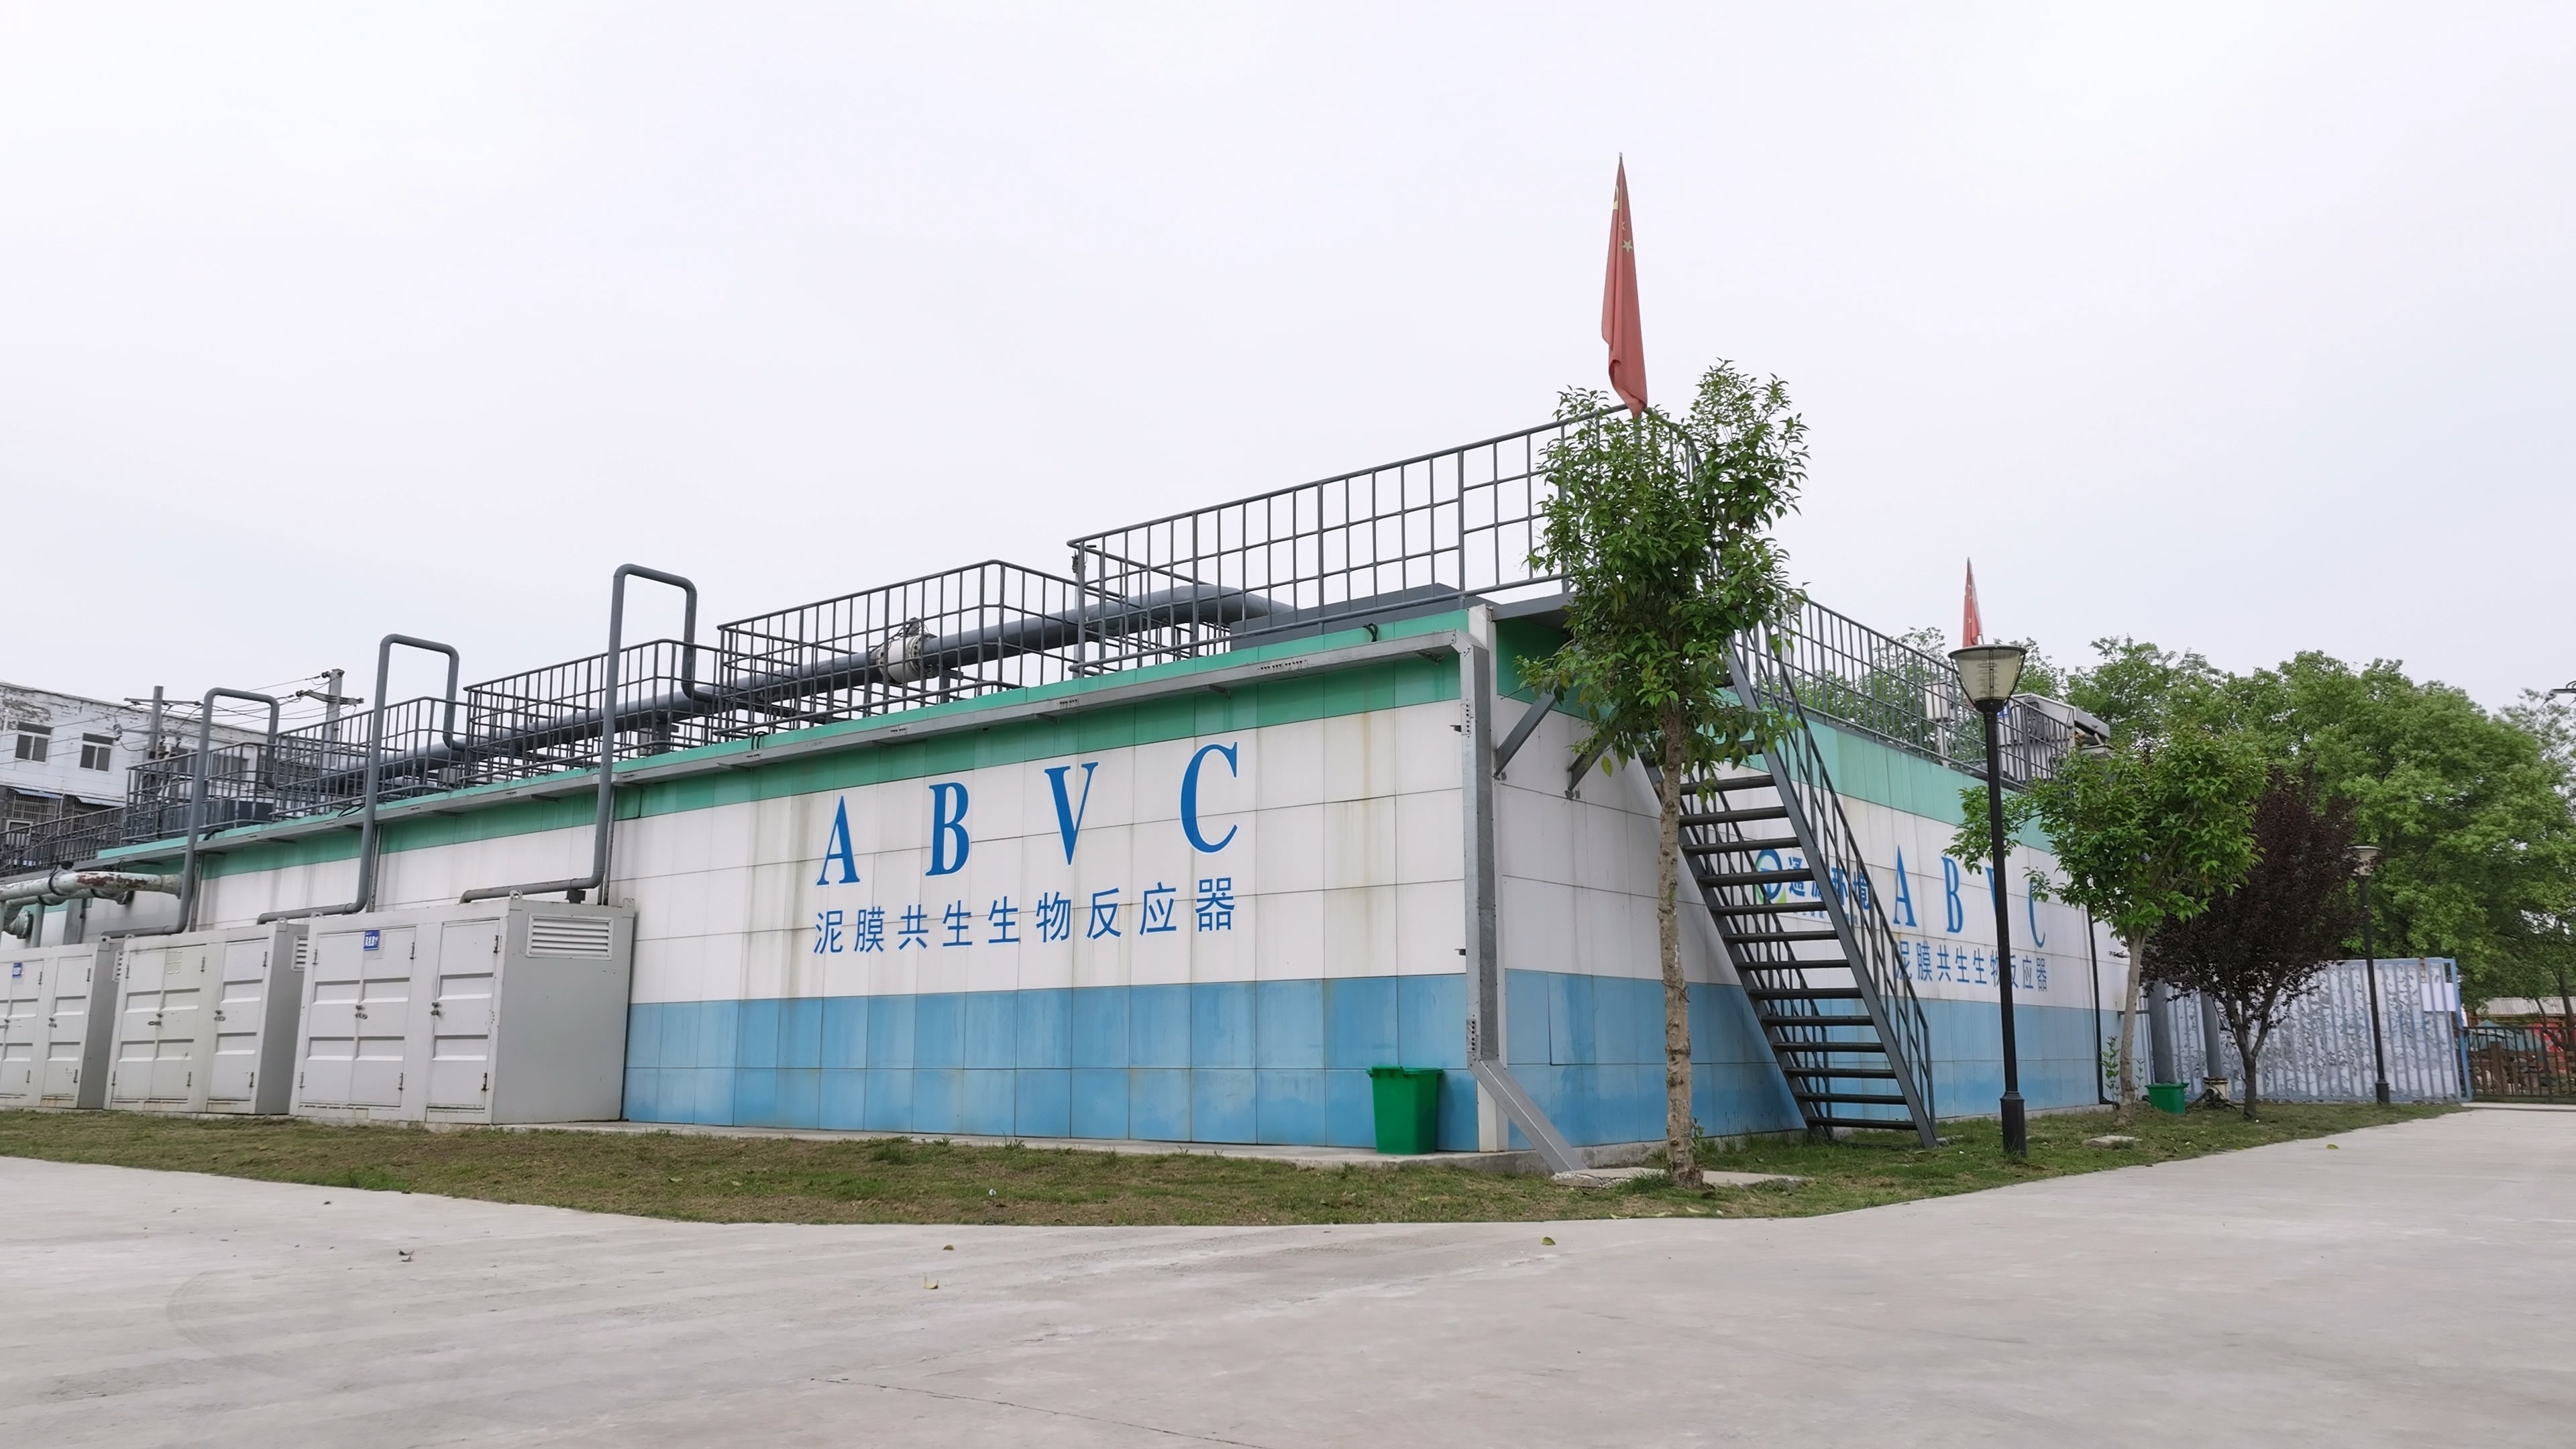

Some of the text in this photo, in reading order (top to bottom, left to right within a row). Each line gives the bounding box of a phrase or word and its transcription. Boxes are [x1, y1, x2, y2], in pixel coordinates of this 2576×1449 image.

[813, 877, 1236, 955] 泥膜共生生物反应器
